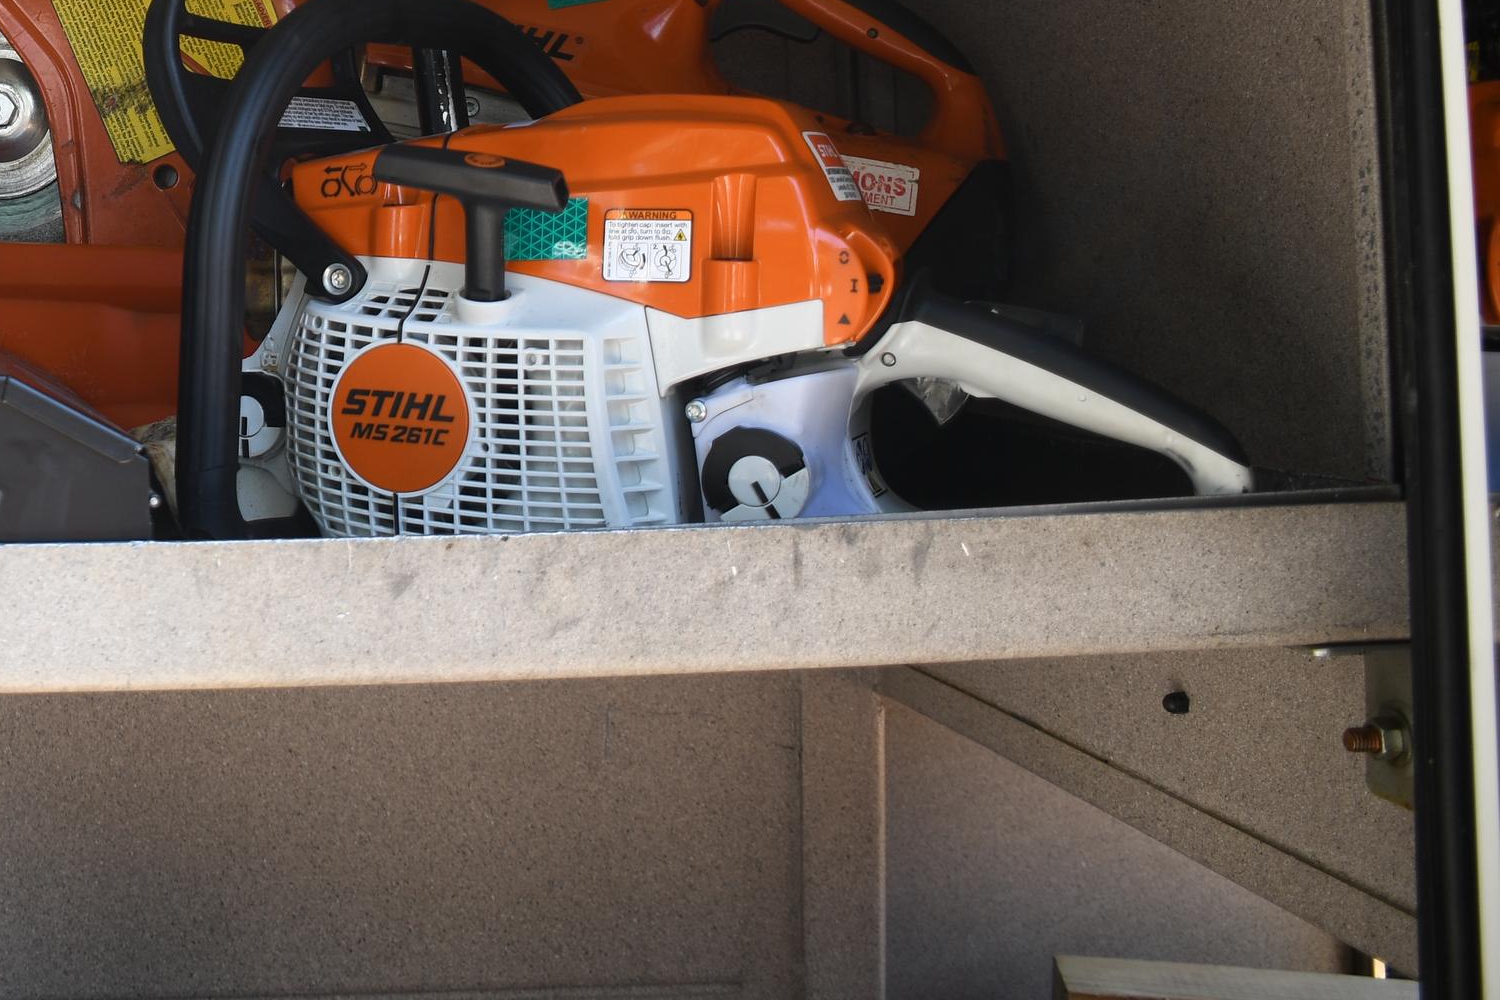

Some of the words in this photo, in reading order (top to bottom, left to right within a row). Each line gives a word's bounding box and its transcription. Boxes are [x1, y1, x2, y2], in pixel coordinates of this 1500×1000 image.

[861, 192, 896, 206] MENT
[628, 211, 677, 220] WARNING
[341, 388, 455, 423] STIHL
